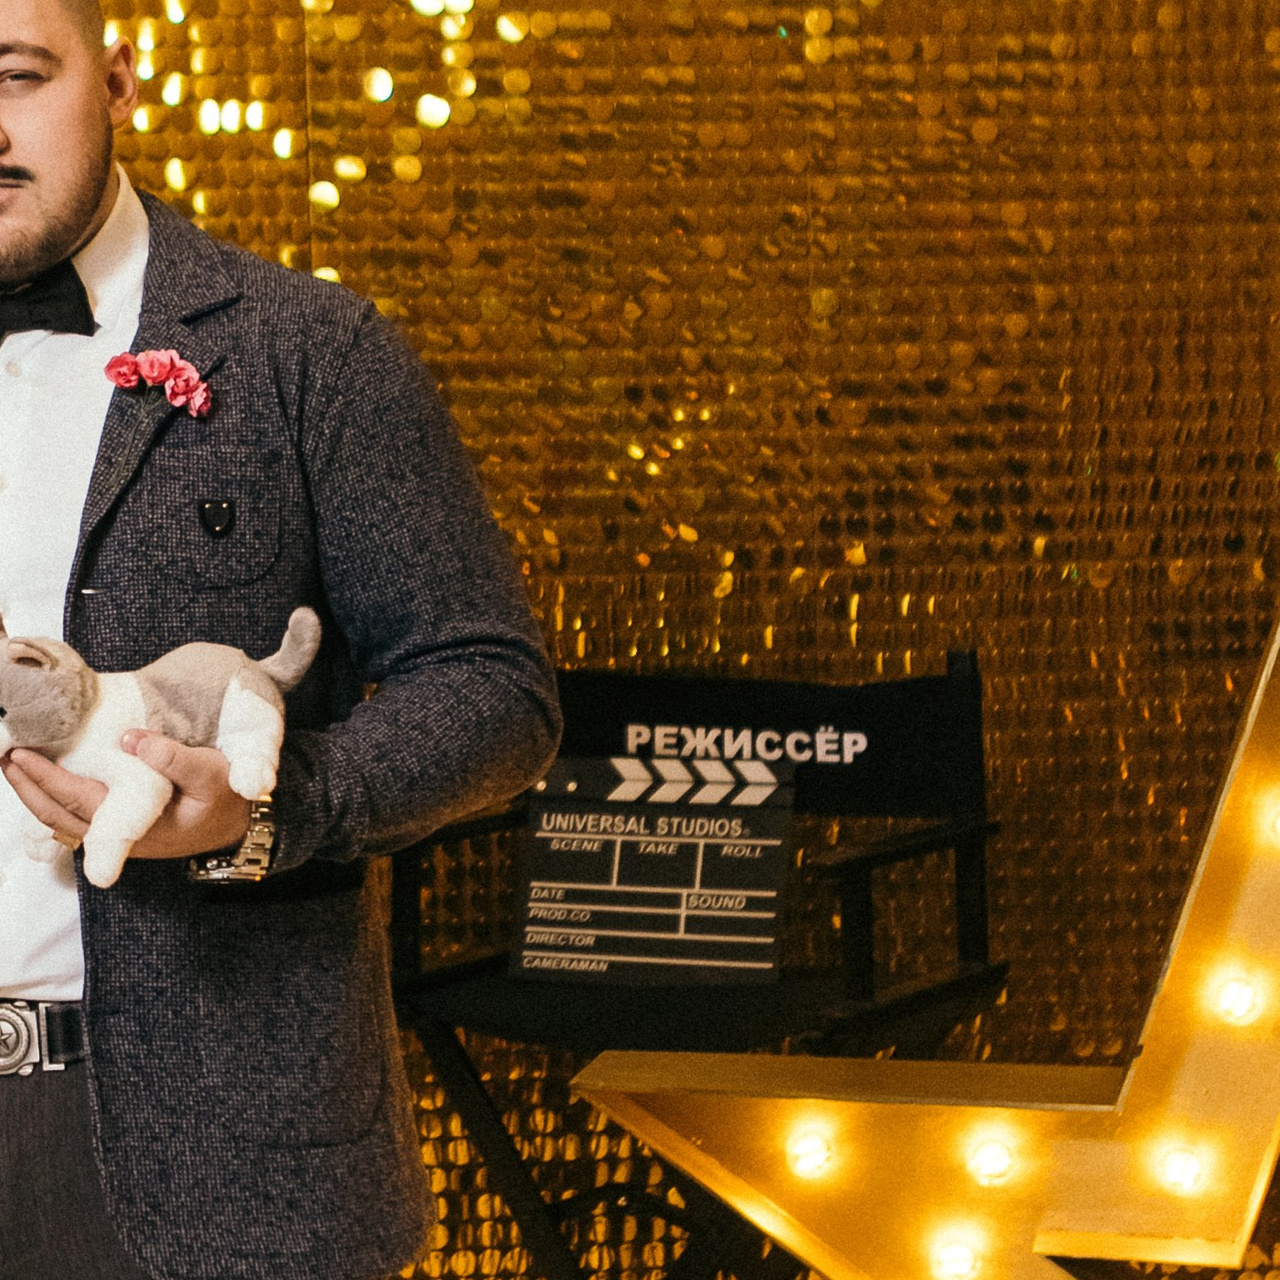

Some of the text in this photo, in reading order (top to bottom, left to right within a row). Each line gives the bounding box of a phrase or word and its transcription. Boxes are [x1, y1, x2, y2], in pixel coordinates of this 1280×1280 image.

[626, 724, 868, 764] РЕЖИССЁР
[541, 812, 743, 838] UNIVERSAL STUDIOS
[550, 838, 604, 853] SCENE
[638, 841, 680, 856] TAKE
[721, 843, 764, 859] ROLL
[529, 887, 566, 901] DATE
[687, 894, 747, 911] SOUND
[525, 932, 596, 948] DIRECTOR
[522, 956, 609, 972] CAMERAMAN
